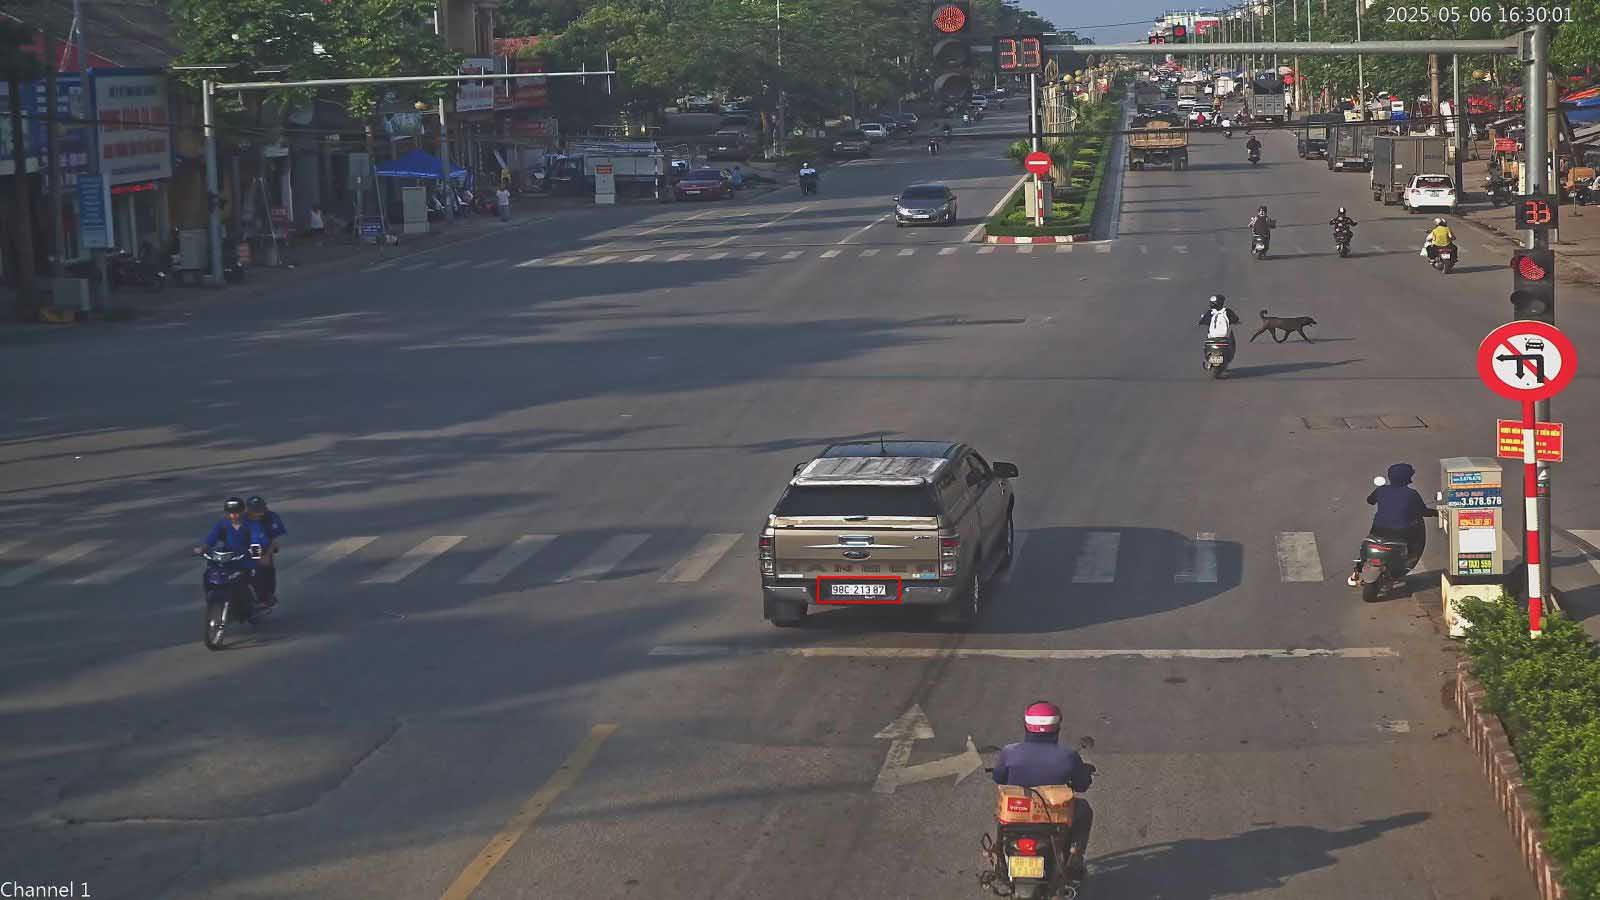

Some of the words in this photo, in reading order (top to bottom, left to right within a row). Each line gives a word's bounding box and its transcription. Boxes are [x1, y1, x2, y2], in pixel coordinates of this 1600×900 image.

[999, 37, 1040, 69] 33
[1525, 200, 1551, 224] 33
[832, 585, 850, 594] 98C
